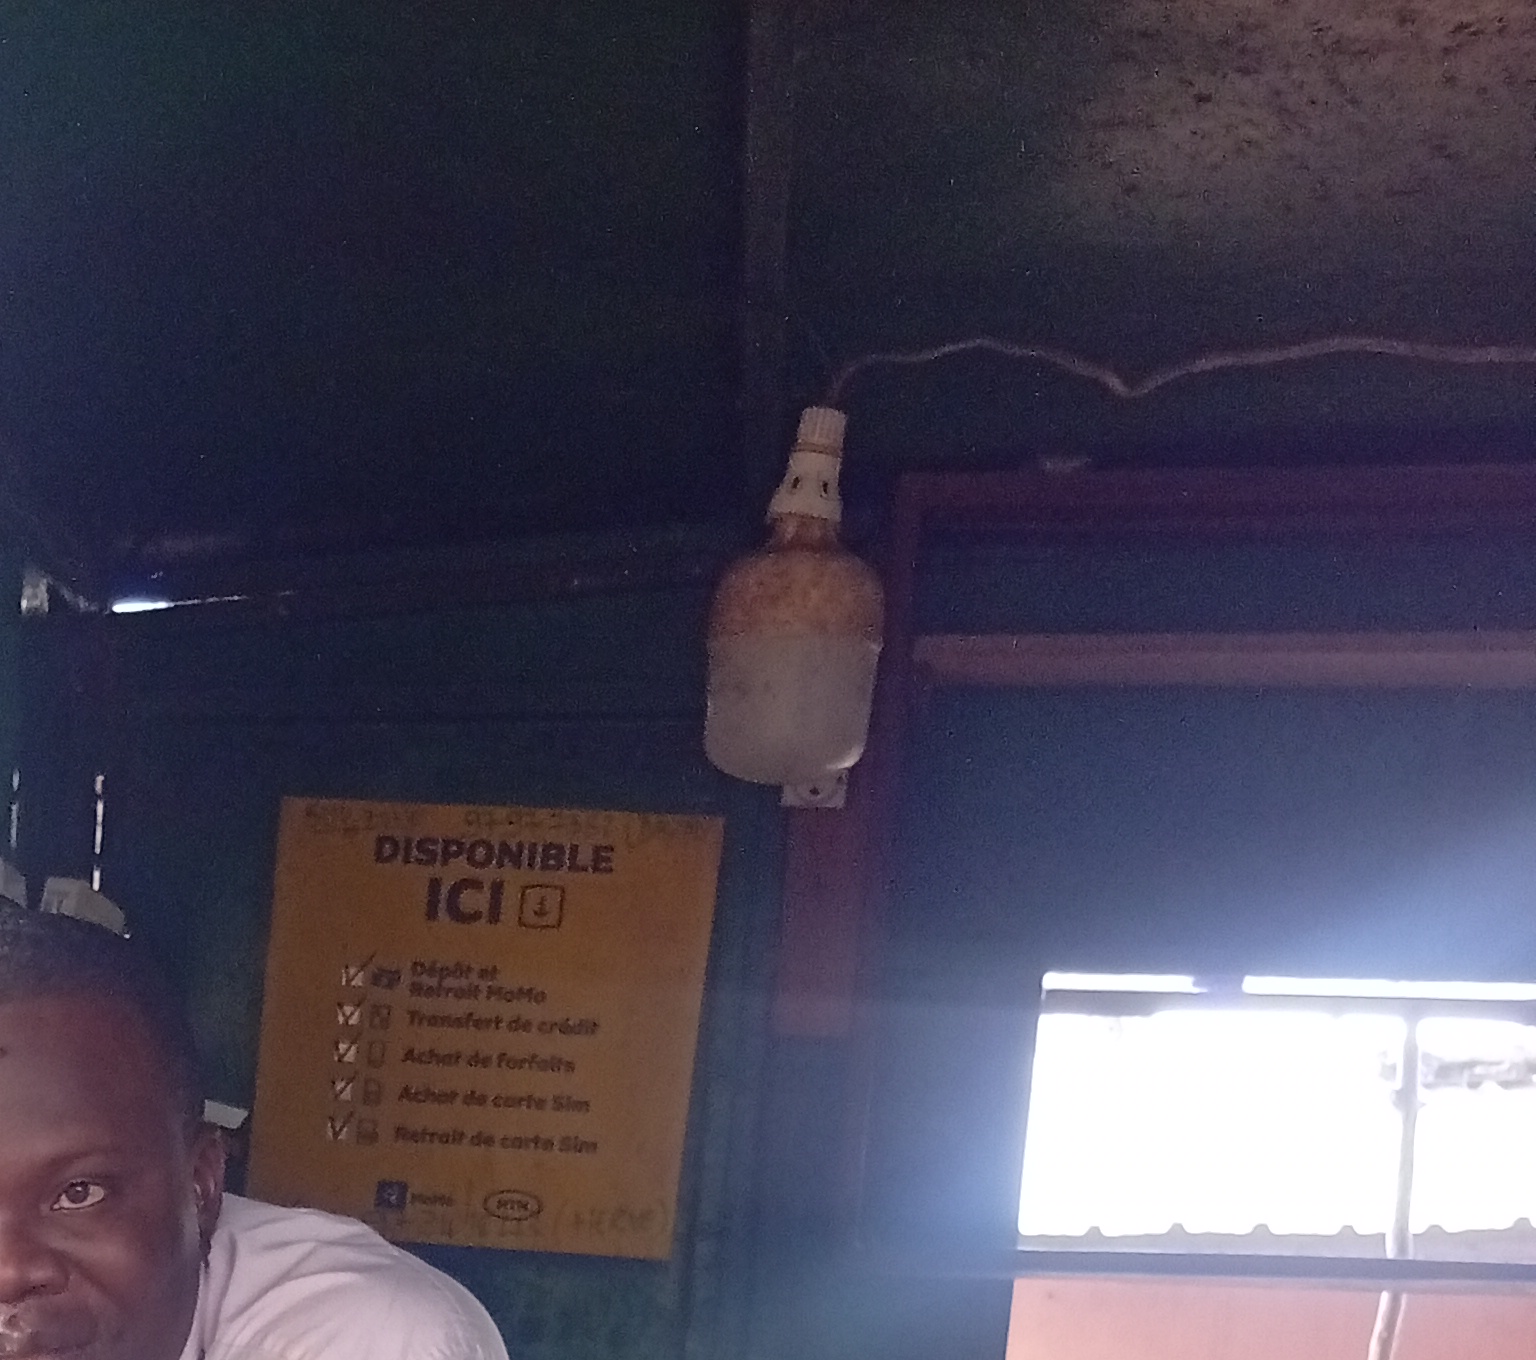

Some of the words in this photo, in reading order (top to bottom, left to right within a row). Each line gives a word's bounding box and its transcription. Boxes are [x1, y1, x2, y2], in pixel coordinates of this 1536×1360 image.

[374, 834, 614, 875] DISPONIBLE
[425, 877, 504, 925] ICI
[485, 985, 547, 1004] MoMo
[407, 1010, 503, 1032] Transfert
[507, 1016, 532, 1033] de
[537, 1018, 600, 1035] crédit
[401, 1049, 462, 1067] Achat
[466, 1051, 493, 1068] de
[496, 1052, 576, 1073] forfaits
[399, 1085, 459, 1105] Achat
[463, 1090, 488, 1107] de
[492, 1094, 547, 1110] carte
[394, 1125, 465, 1145] Retrait
[470, 1131, 495, 1147] de
[500, 1134, 555, 1150] carte
